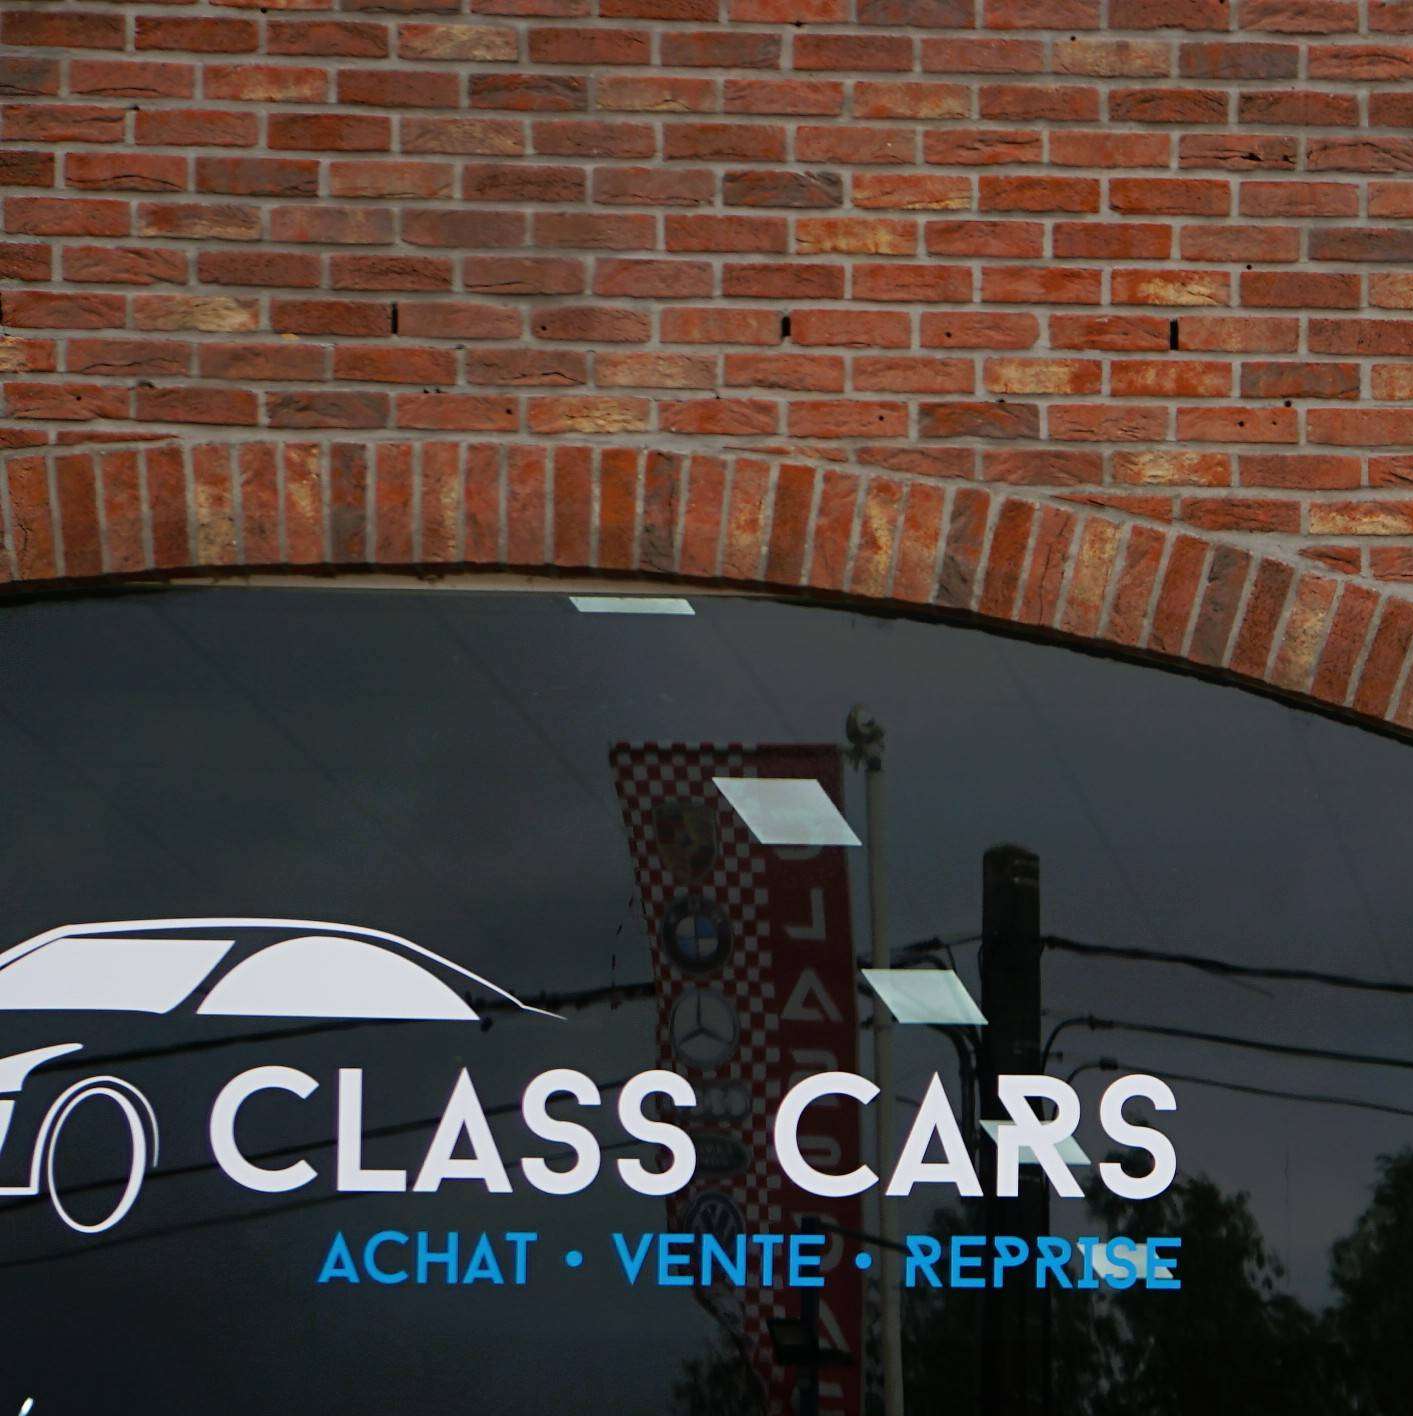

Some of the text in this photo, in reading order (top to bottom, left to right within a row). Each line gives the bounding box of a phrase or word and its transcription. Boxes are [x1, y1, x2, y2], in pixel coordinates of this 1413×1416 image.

[211, 1065, 1178, 1200] CLASS CARS
[316, 1229, 1183, 1292] ACHAT VENTE REPRISE
